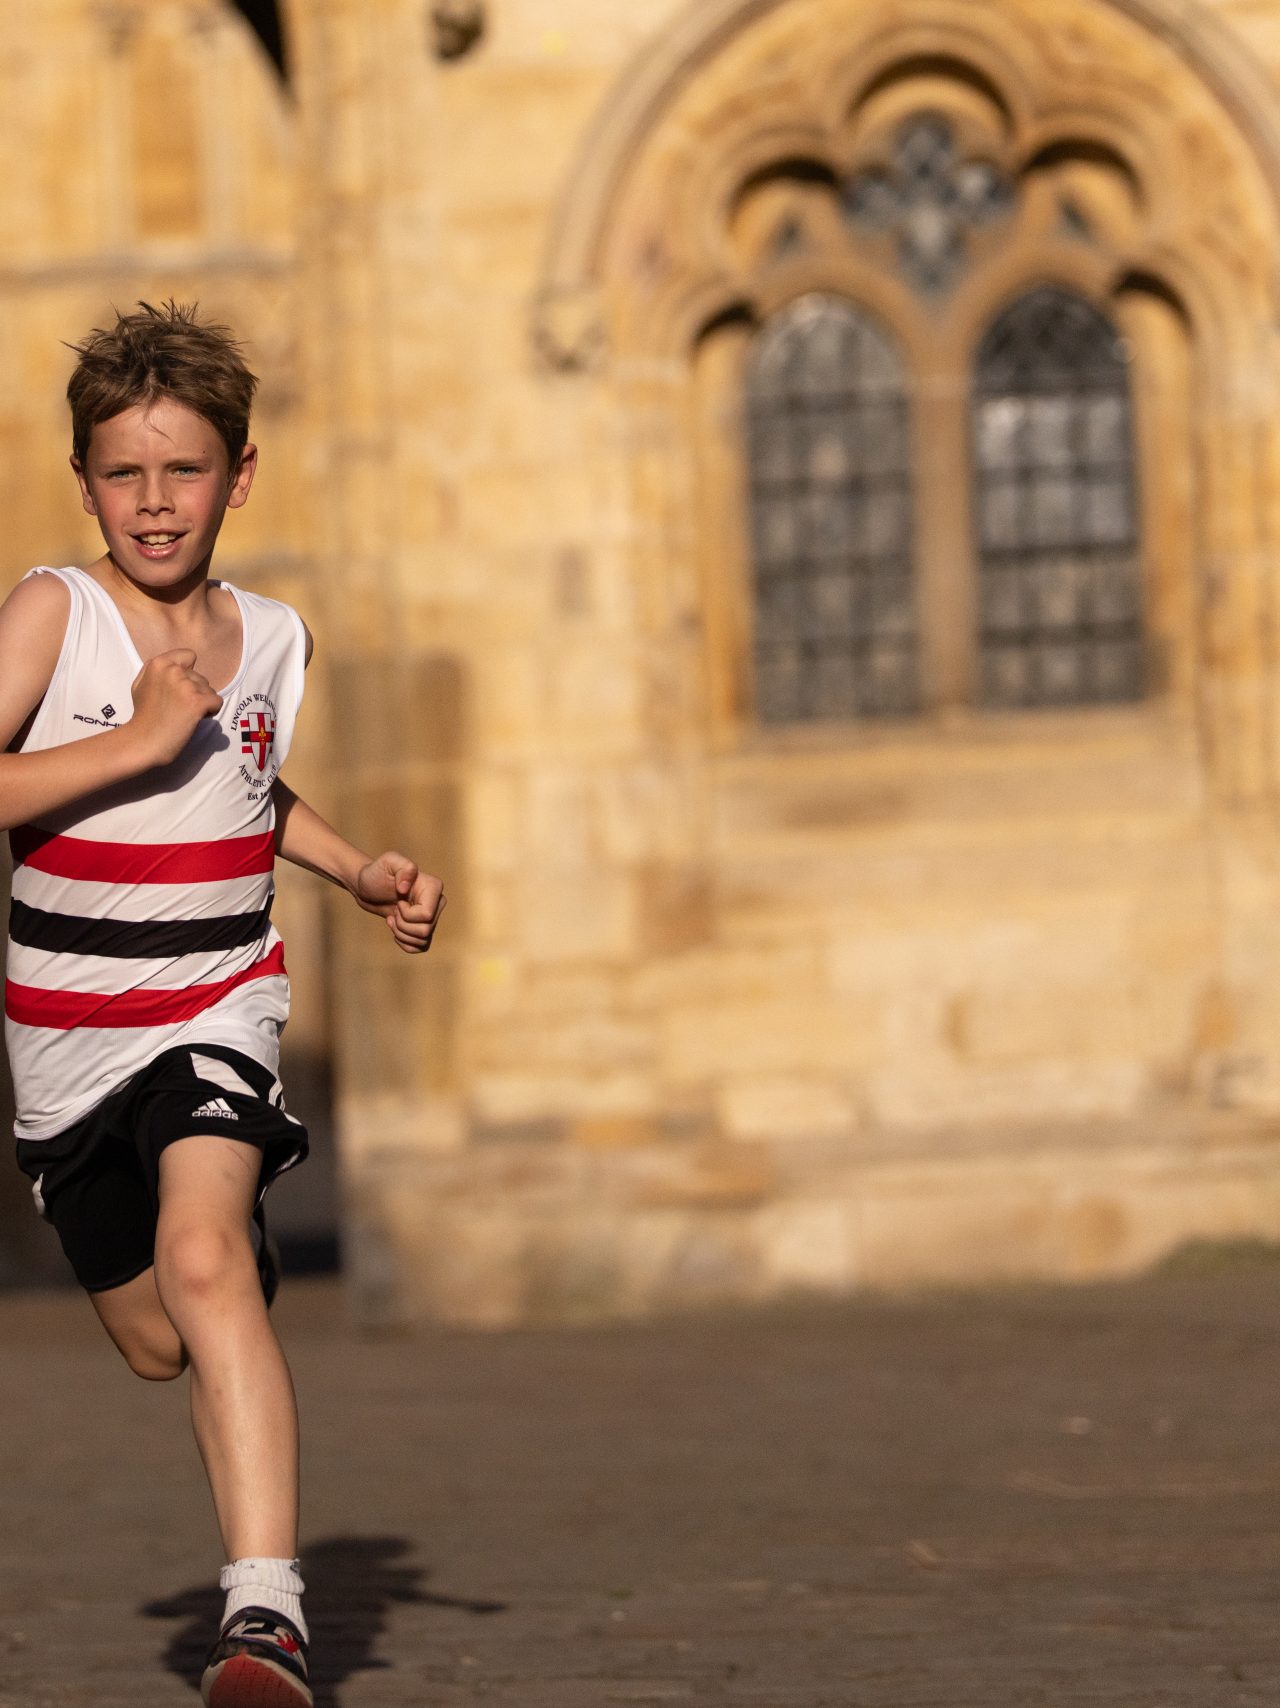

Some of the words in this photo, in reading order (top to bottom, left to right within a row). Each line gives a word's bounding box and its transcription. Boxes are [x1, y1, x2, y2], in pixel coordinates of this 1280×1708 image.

[231, 696, 253, 731] LINCOLN
[73, 714, 119, 728] RONH
[192, 1110, 238, 1120] adidas
